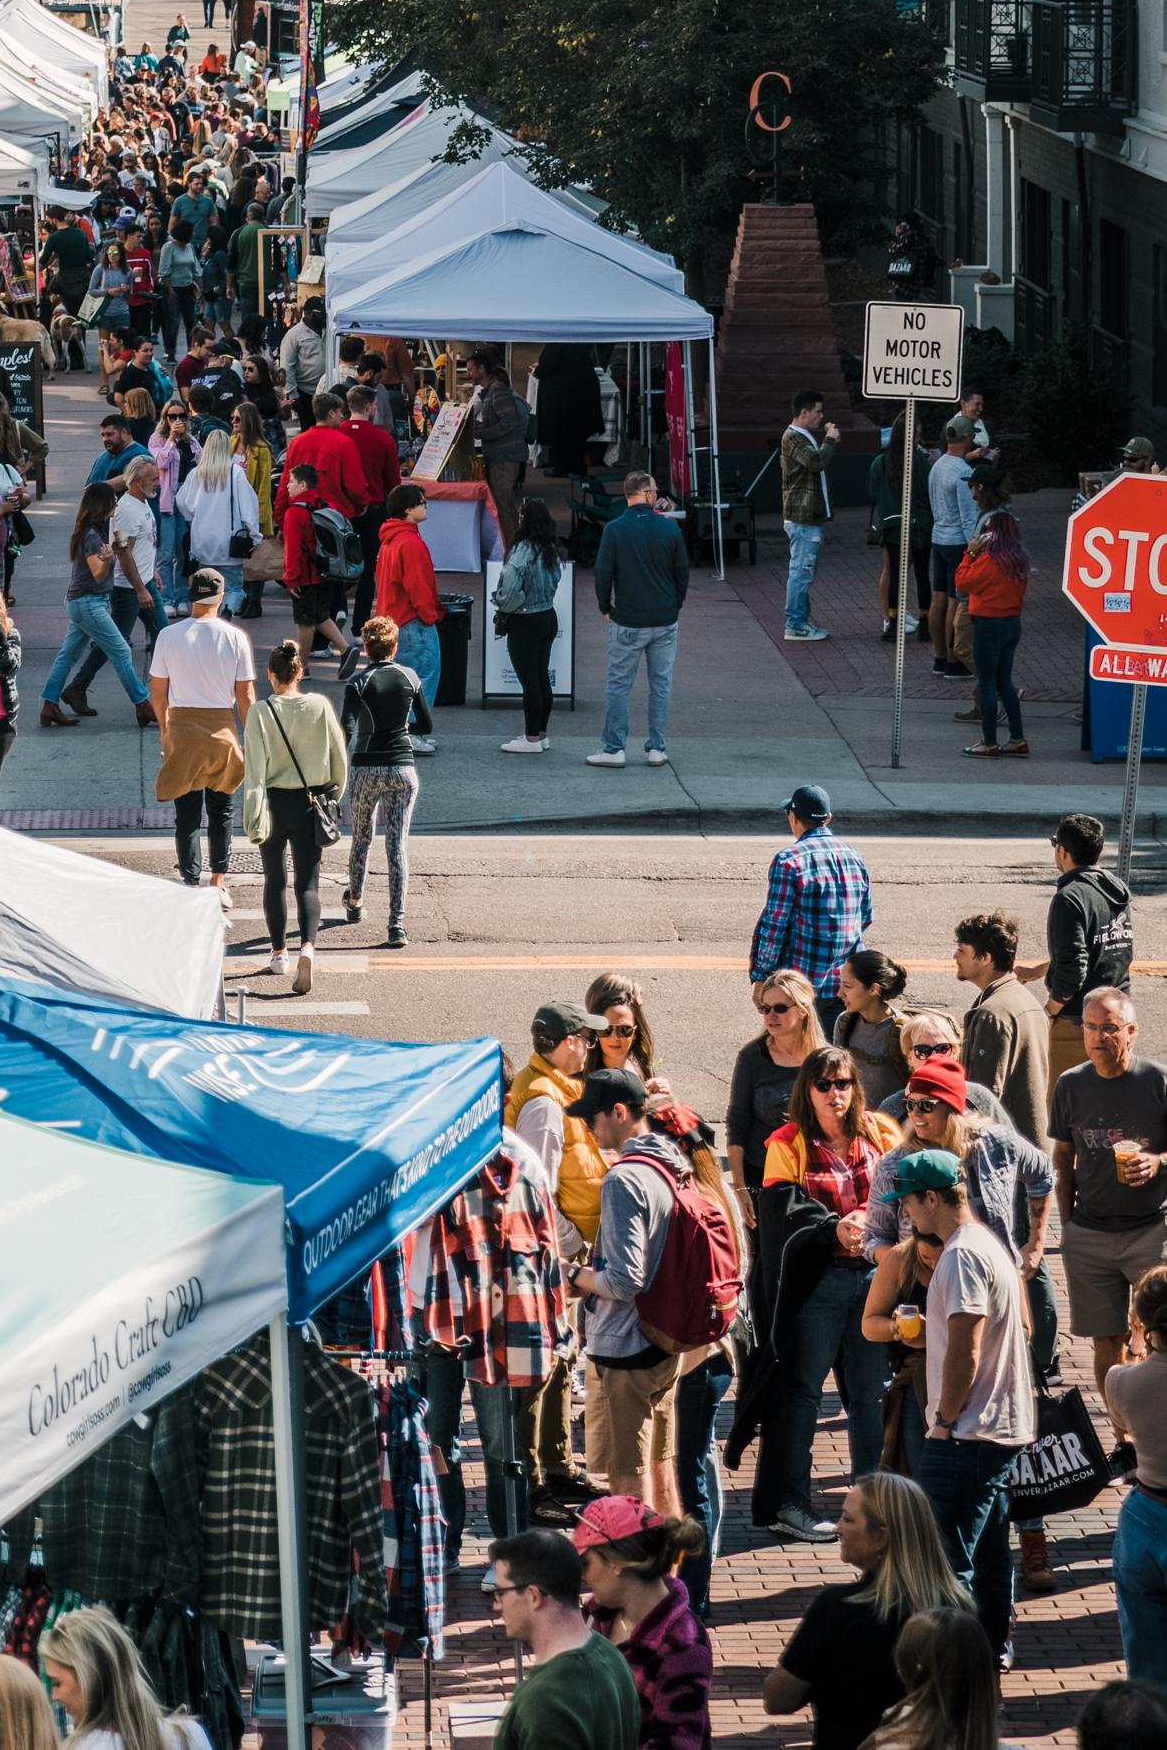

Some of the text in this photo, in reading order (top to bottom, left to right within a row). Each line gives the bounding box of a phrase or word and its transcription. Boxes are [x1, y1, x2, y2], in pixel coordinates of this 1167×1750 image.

[903, 312, 926, 331] NO
[886, 339, 941, 359] MOTOR
[872, 366, 953, 388] VEHICLES
[1078, 526, 1167, 595] STO
[1099, 653, 1167, 678] ALL WA
[1083, 1128, 1123, 1140] BIKE
[1083, 1138, 1150, 1149] WOS
[303, 1207, 354, 1275] OUTDOOR
[353, 1186, 378, 1233] GEAR
[379, 1161, 411, 1211] THAT'S
[408, 1144, 434, 1187] KIND
[442, 1117, 461, 1157] THE
[28, 1276, 204, 1437] Colorado Craft CBD
[66, 1361, 172, 1448] cowgirlsoss.com @cowgirlsoss
[1010, 1432, 1091, 1486] BAAAR
[1013, 1468, 1095, 1497] ENVERAZAAR.COM
